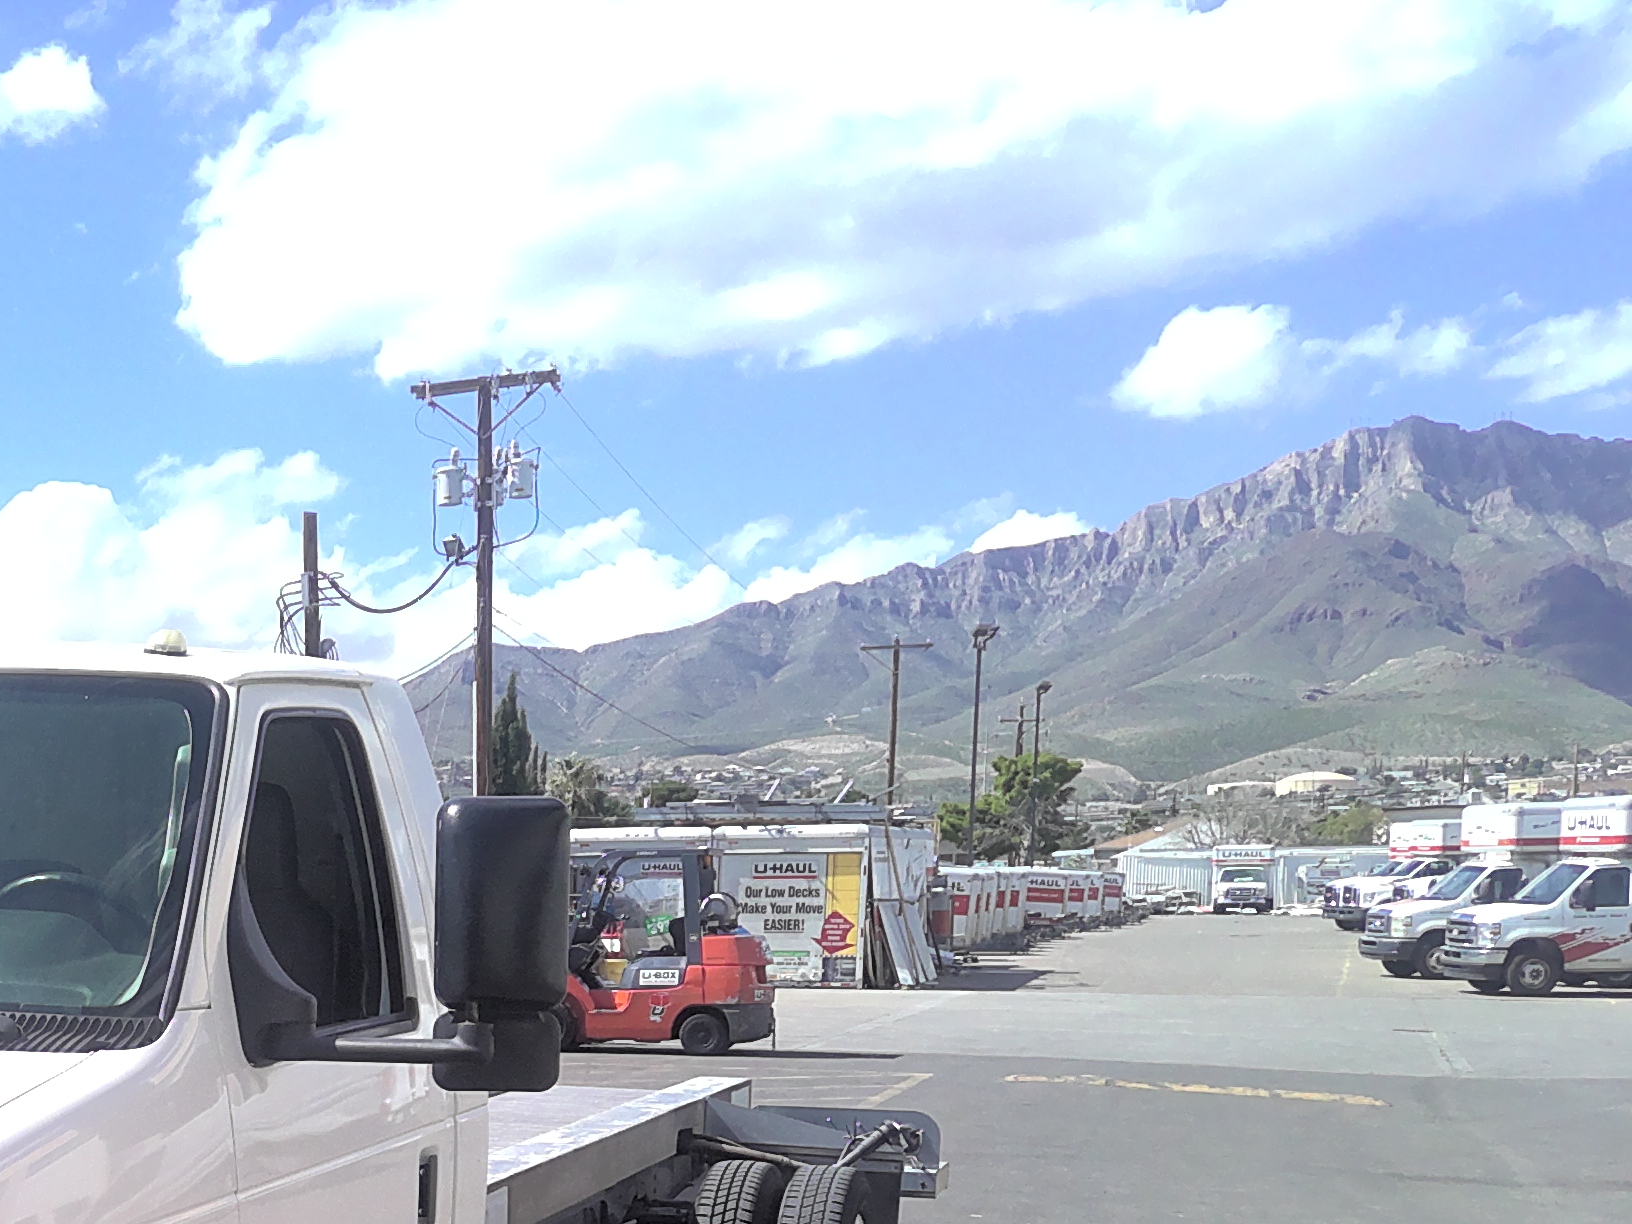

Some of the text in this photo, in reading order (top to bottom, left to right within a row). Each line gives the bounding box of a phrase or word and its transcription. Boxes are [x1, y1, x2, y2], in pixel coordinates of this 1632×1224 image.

[1568, 815, 1610, 831] U-HAUL
[641, 863, 683, 871] U-HAUL
[754, 863, 817, 874] U-HAUL
[1029, 878, 1061, 887] -HAUL
[744, 886, 820, 898] Our Low Decks
[739, 902, 823, 914] Make Your Move
[763, 919, 805, 931] EASIER!
[642, 971, 677, 979] U-BOX
